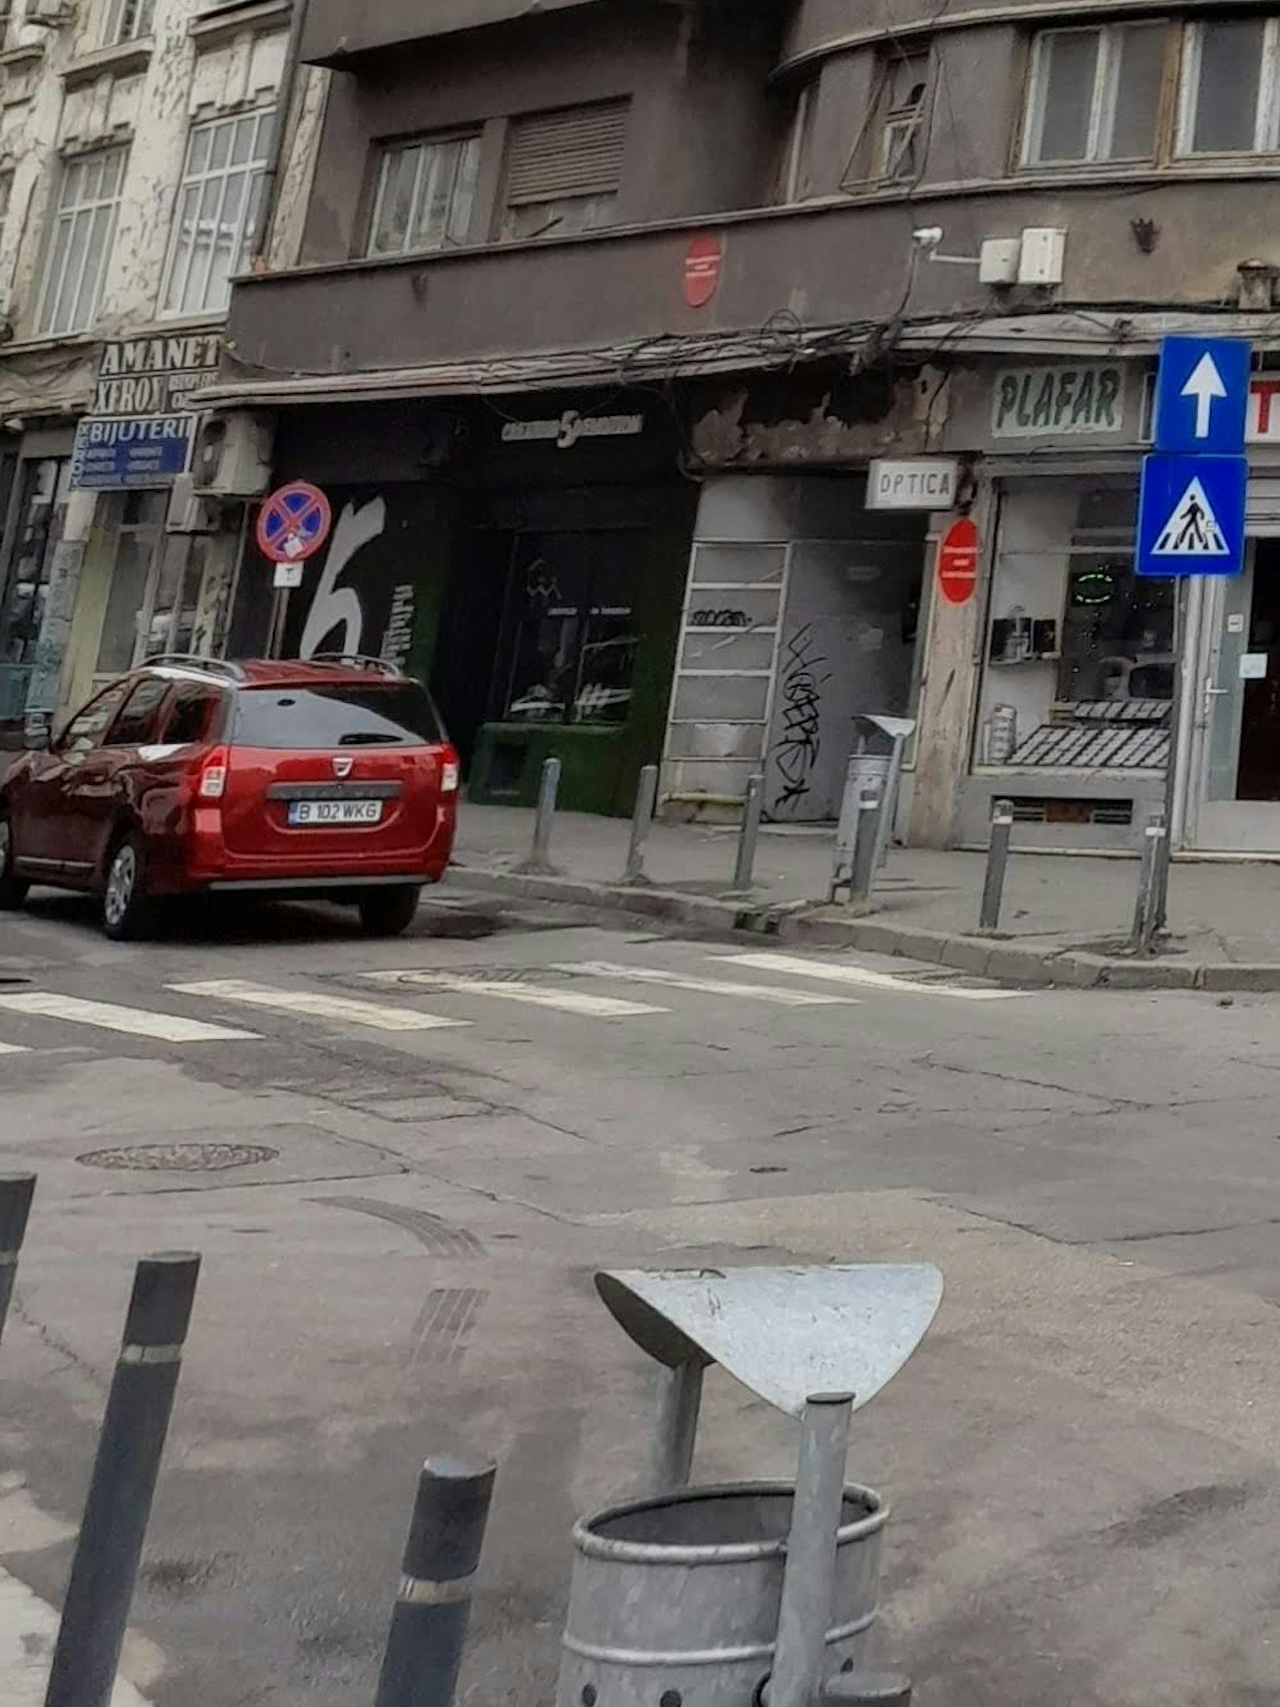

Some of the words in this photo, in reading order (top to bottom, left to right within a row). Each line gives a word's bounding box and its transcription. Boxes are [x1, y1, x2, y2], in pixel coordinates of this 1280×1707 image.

[101, 336, 220, 375] AMANET
[997, 368, 1119, 430] PLAFAR
[89, 418, 191, 446] BIJUTERII
[880, 473, 950, 495] OPTICA
[299, 804, 311, 820] B
[317, 804, 341, 819] 102
[343, 803, 377, 818] WKG
